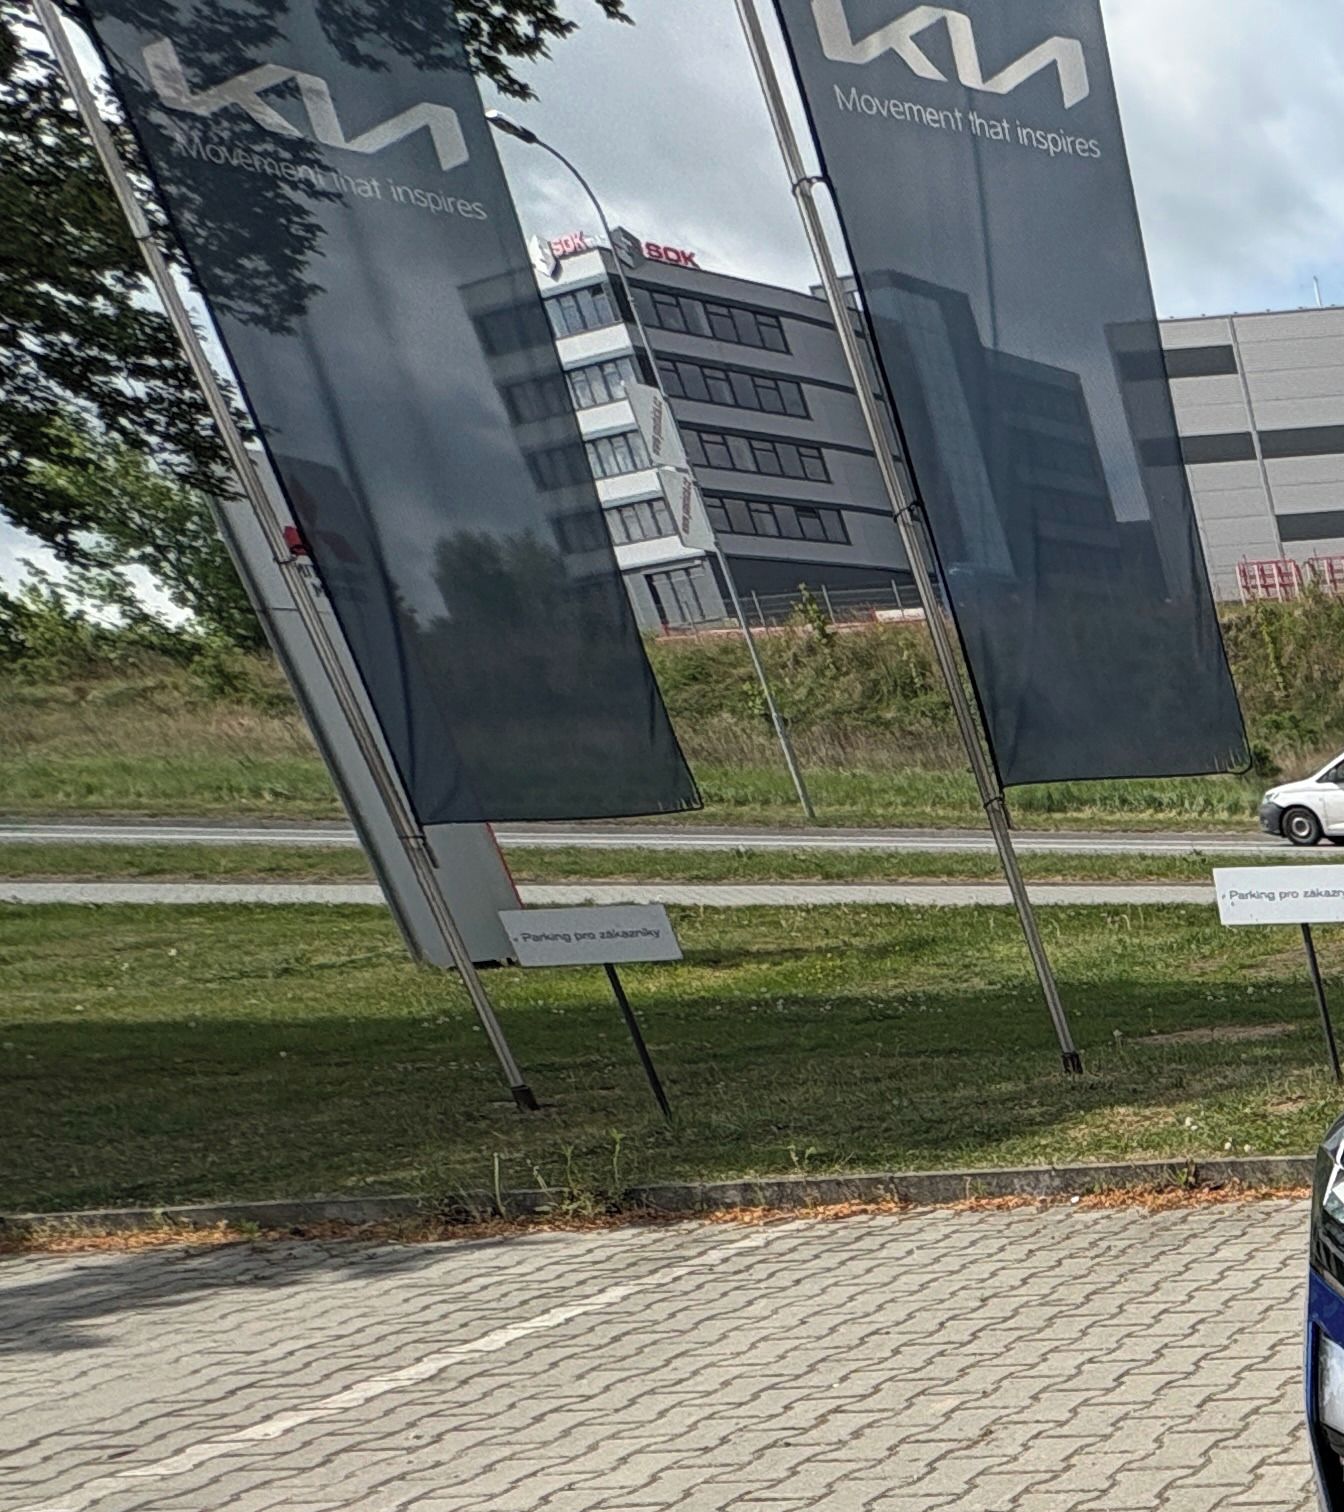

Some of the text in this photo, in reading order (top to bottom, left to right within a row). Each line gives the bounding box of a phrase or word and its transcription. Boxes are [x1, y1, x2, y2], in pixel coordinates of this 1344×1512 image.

[142, 36, 470, 171] KIA
[833, 84, 1101, 158] Movement that inspires
[179, 141, 328, 187] Movement
[390, 178, 488, 220] inspires
[1229, 889, 1276, 901] Parking
[1278, 890, 1299, 901] pro
[521, 932, 572, 943] Parking
[574, 931, 596, 943] pro
